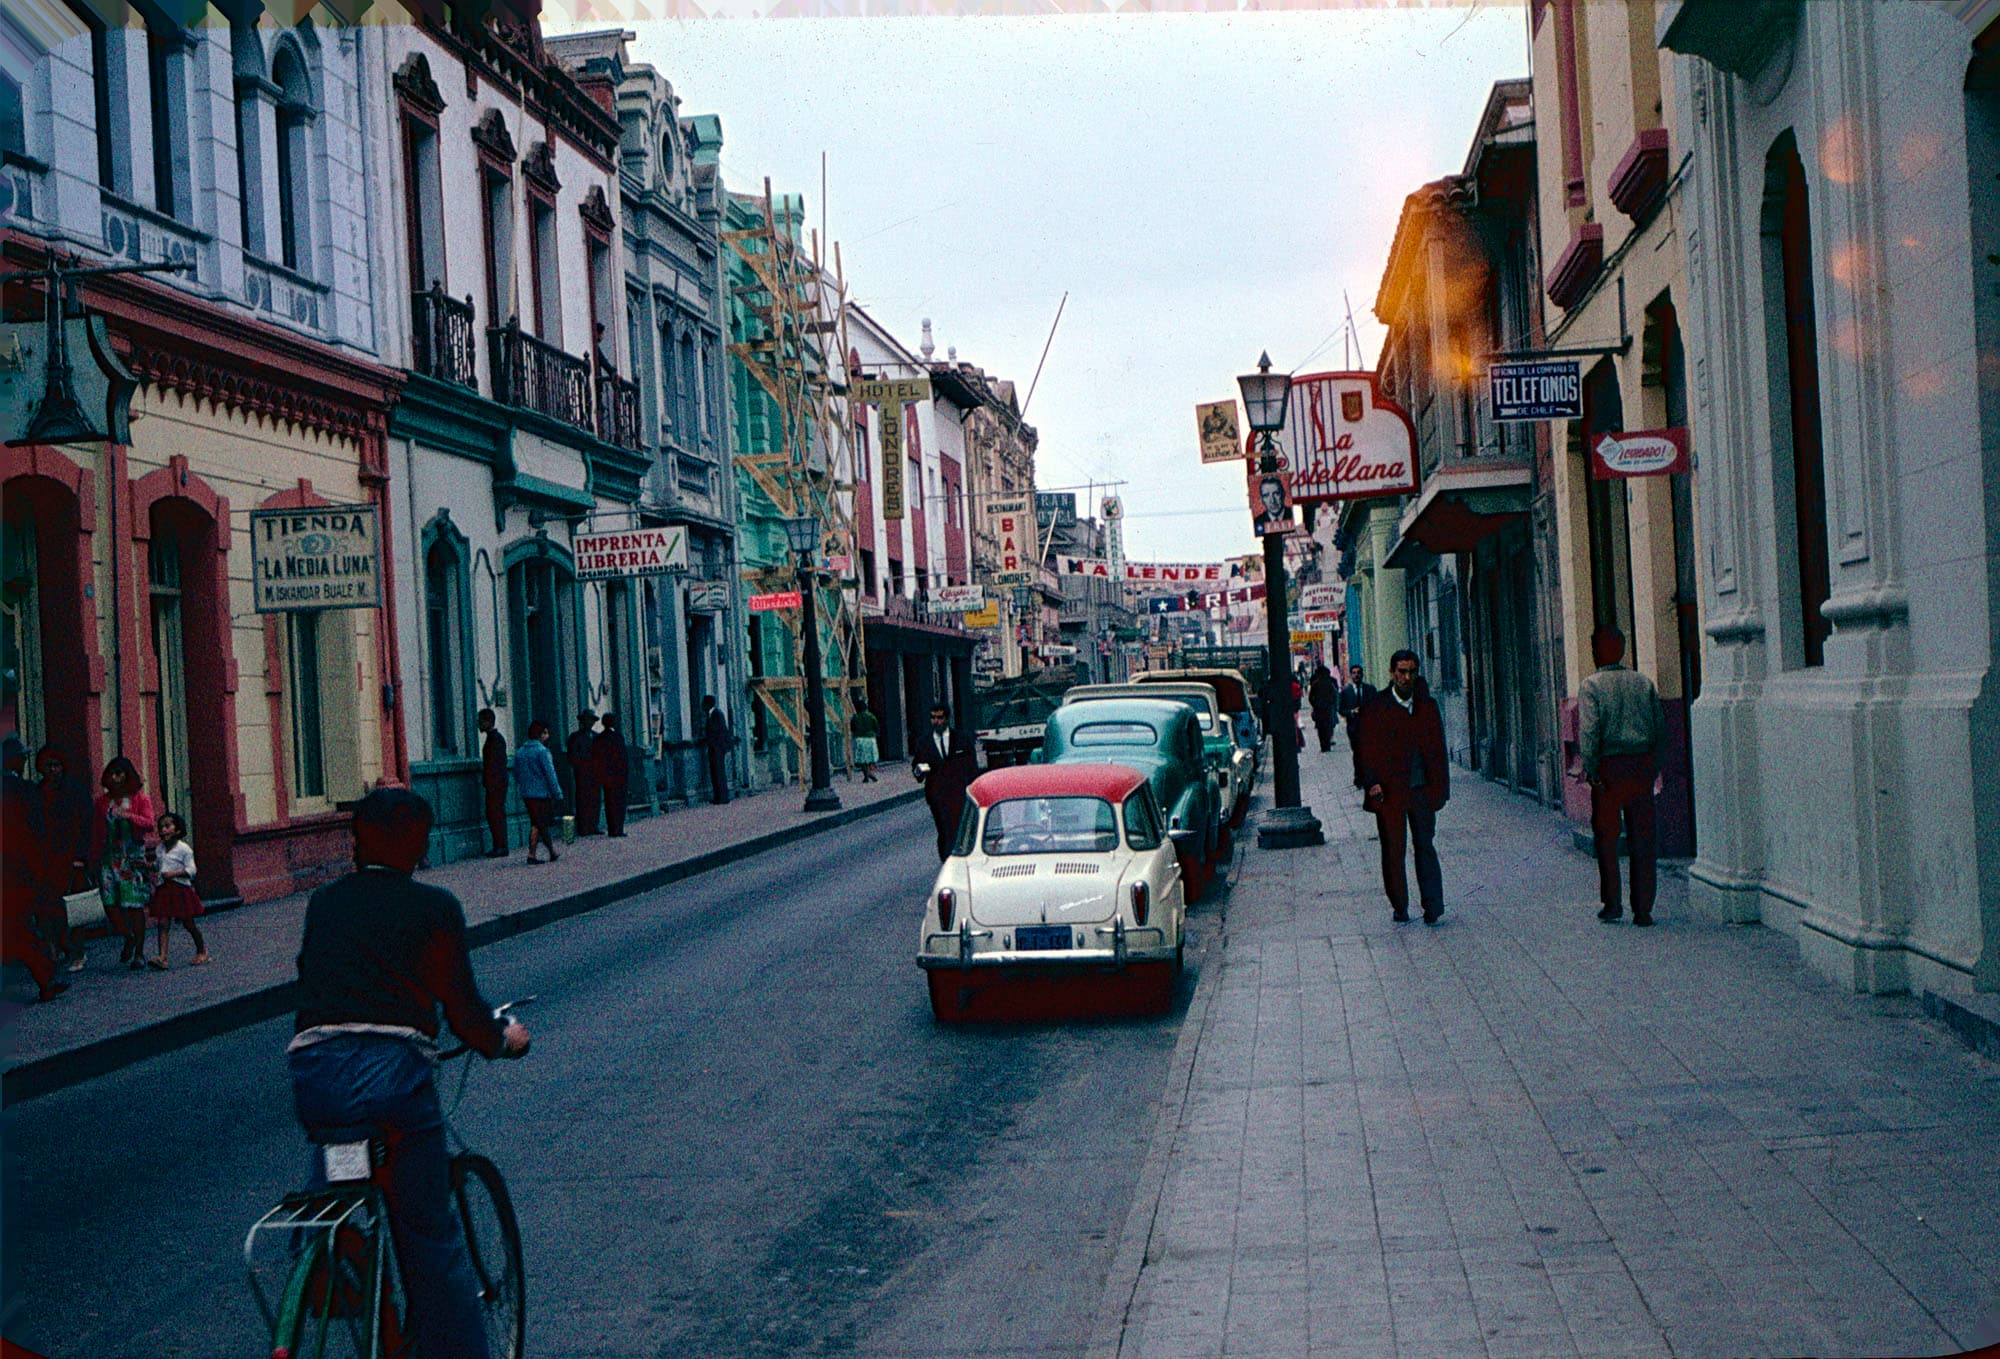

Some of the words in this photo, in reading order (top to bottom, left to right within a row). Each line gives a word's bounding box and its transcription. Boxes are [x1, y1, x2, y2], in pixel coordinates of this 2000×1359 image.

[1518, 367, 1526, 375] DE
[1527, 366, 1536, 375] LA
[860, 383, 921, 398] HOTEL
[1493, 375, 1578, 406] TELEFONOS
[1314, 382, 1355, 452] La
[1518, 407, 1529, 416] DE
[1531, 405, 1555, 415] CHILE
[883, 408, 901, 511] LONDRES
[1040, 493, 1069, 507] RAN
[1037, 510, 1075, 523] OTEL
[262, 515, 366, 541] TIENDA
[577, 533, 666, 553] IMPRENTA
[1001, 517, 1017, 572] BAR
[285, 555, 331, 578] MEDIA
[578, 550, 661, 571] LIBRERIA
[992, 571, 1032, 585] LONDRES
[1093, 565, 1220, 580] ALENDE
[1311, 594, 1335, 604] ROMA
